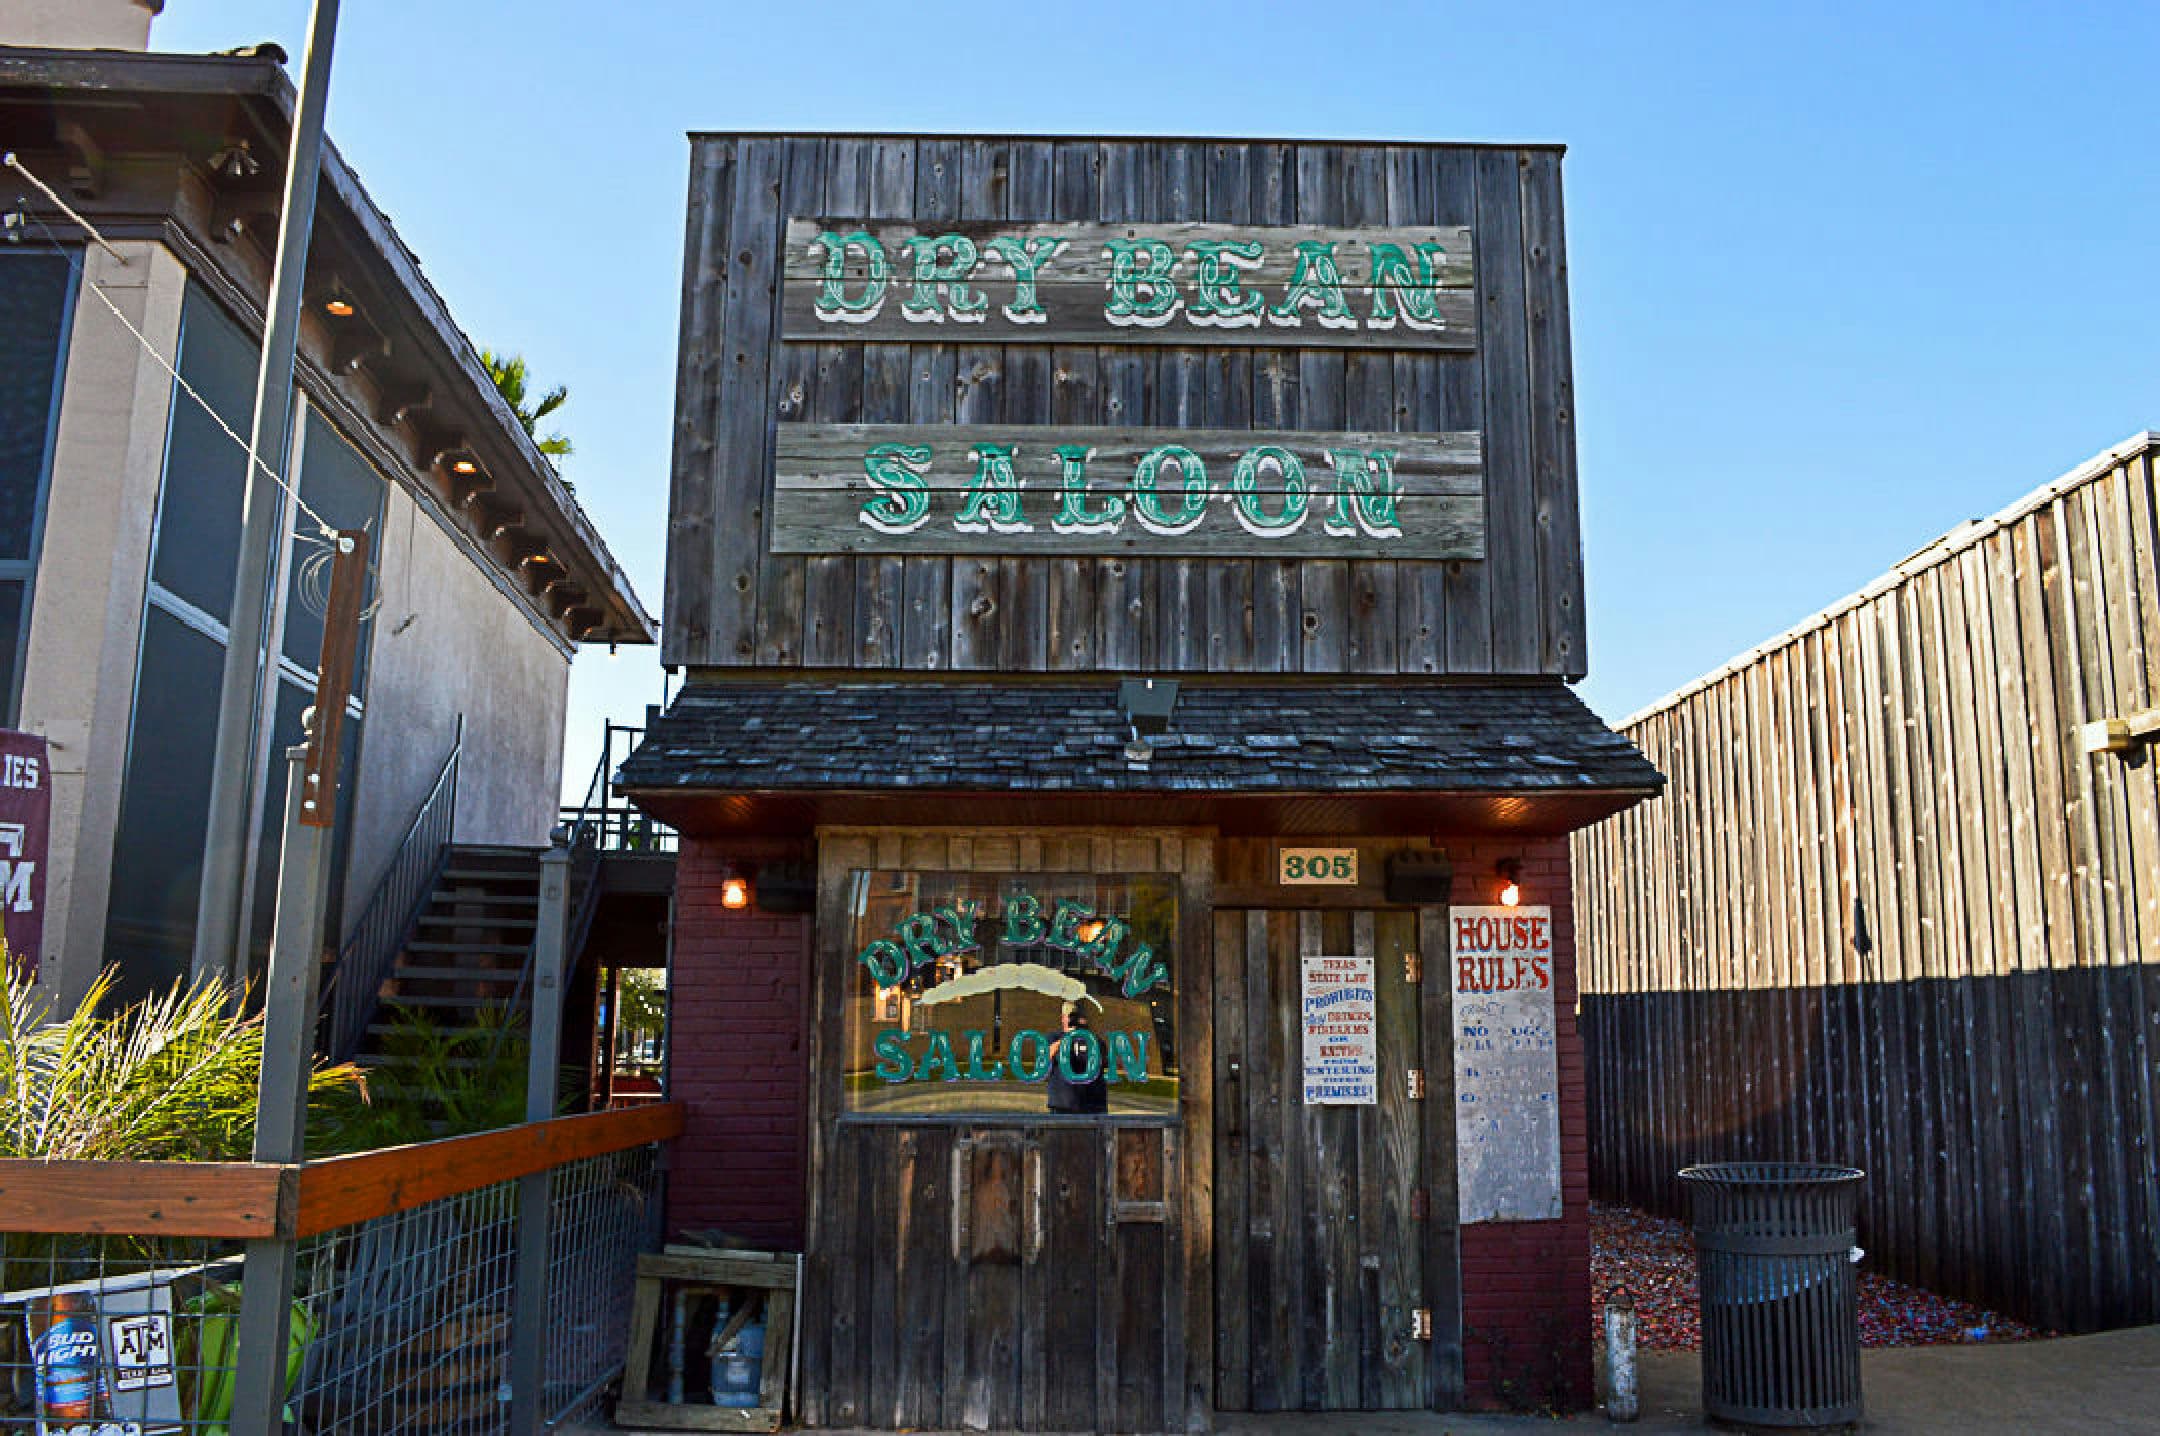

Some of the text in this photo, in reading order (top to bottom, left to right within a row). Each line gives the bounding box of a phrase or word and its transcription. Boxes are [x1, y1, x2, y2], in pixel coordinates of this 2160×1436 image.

[807, 231, 1448, 331] DRY BEAN
[859, 443, 1404, 537] SALOON
[1285, 855, 1351, 878] 305
[857, 895, 1169, 998] DRY BEAN
[1455, 916, 1550, 951] HOUSE
[1323, 959, 1358, 969] TEXAS
[1456, 955, 1550, 993] RULES
[873, 1027, 1151, 1085] SALOON
[49, 1331, 95, 1347] BUD
